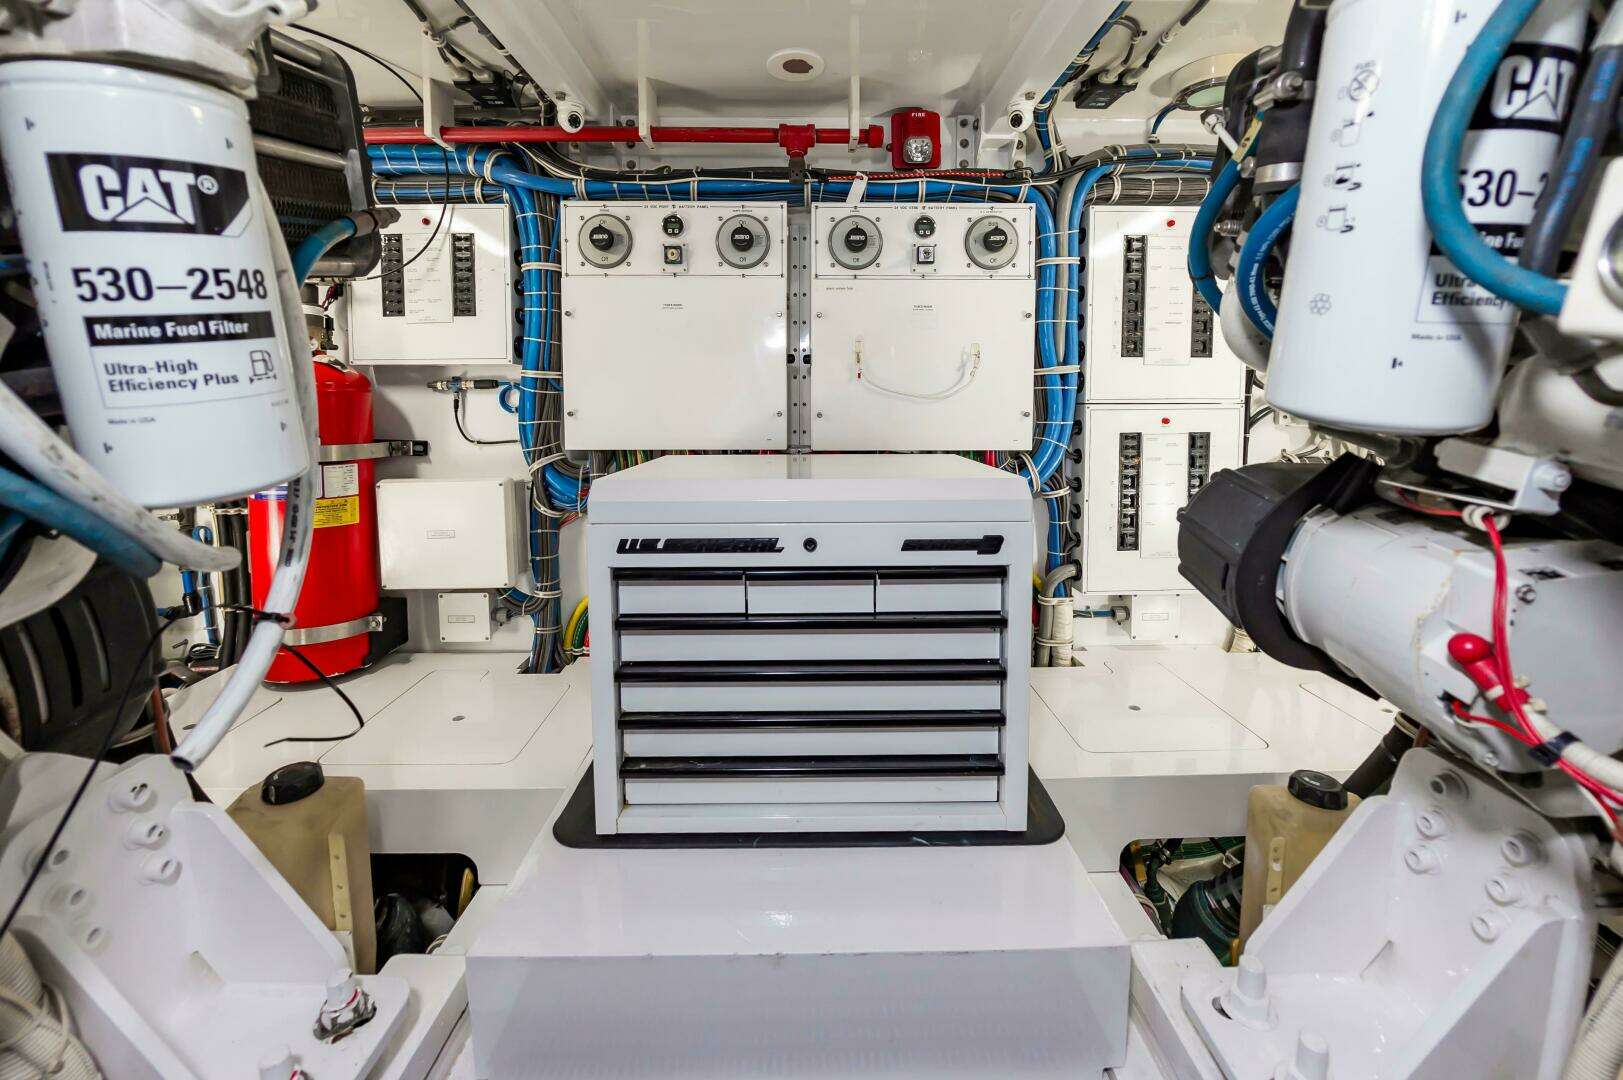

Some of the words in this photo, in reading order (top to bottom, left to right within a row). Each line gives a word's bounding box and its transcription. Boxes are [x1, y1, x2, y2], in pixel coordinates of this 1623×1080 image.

[93, 323, 162, 340] Marine
[164, 321, 206, 337] Fuel
[209, 320, 249, 335] Filter
[104, 359, 199, 377] Ultra-High
[108, 377, 198, 392] Efficiency
[203, 373, 239, 386] Plus
